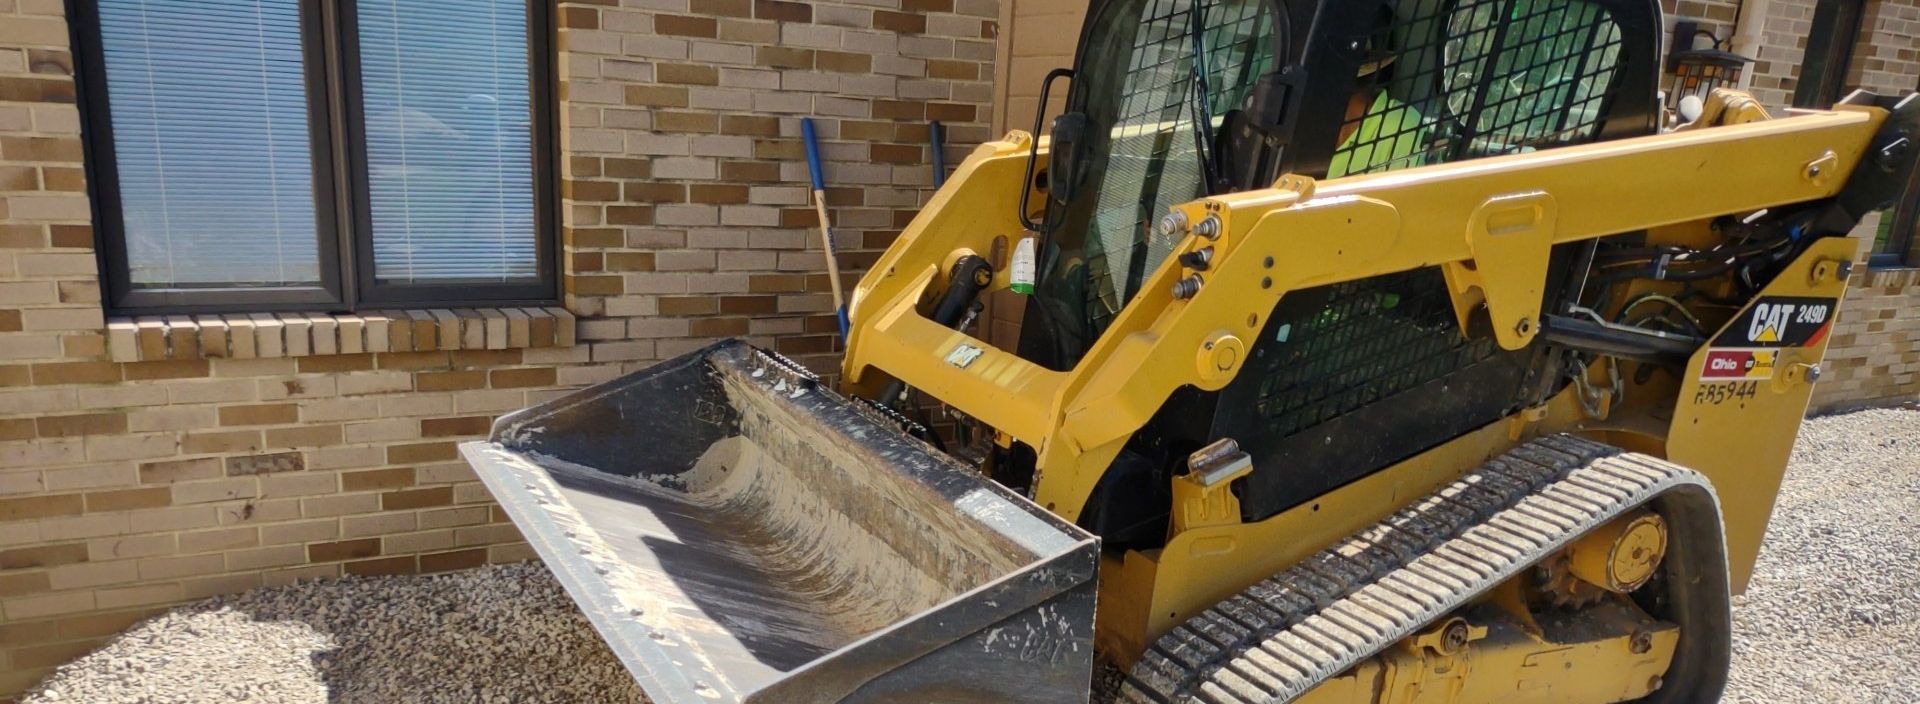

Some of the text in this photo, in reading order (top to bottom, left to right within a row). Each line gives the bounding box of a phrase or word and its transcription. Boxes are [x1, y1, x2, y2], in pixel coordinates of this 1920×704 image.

[1748, 303, 1828, 342] CAT 249D
[1711, 358, 1737, 370] Ohio
